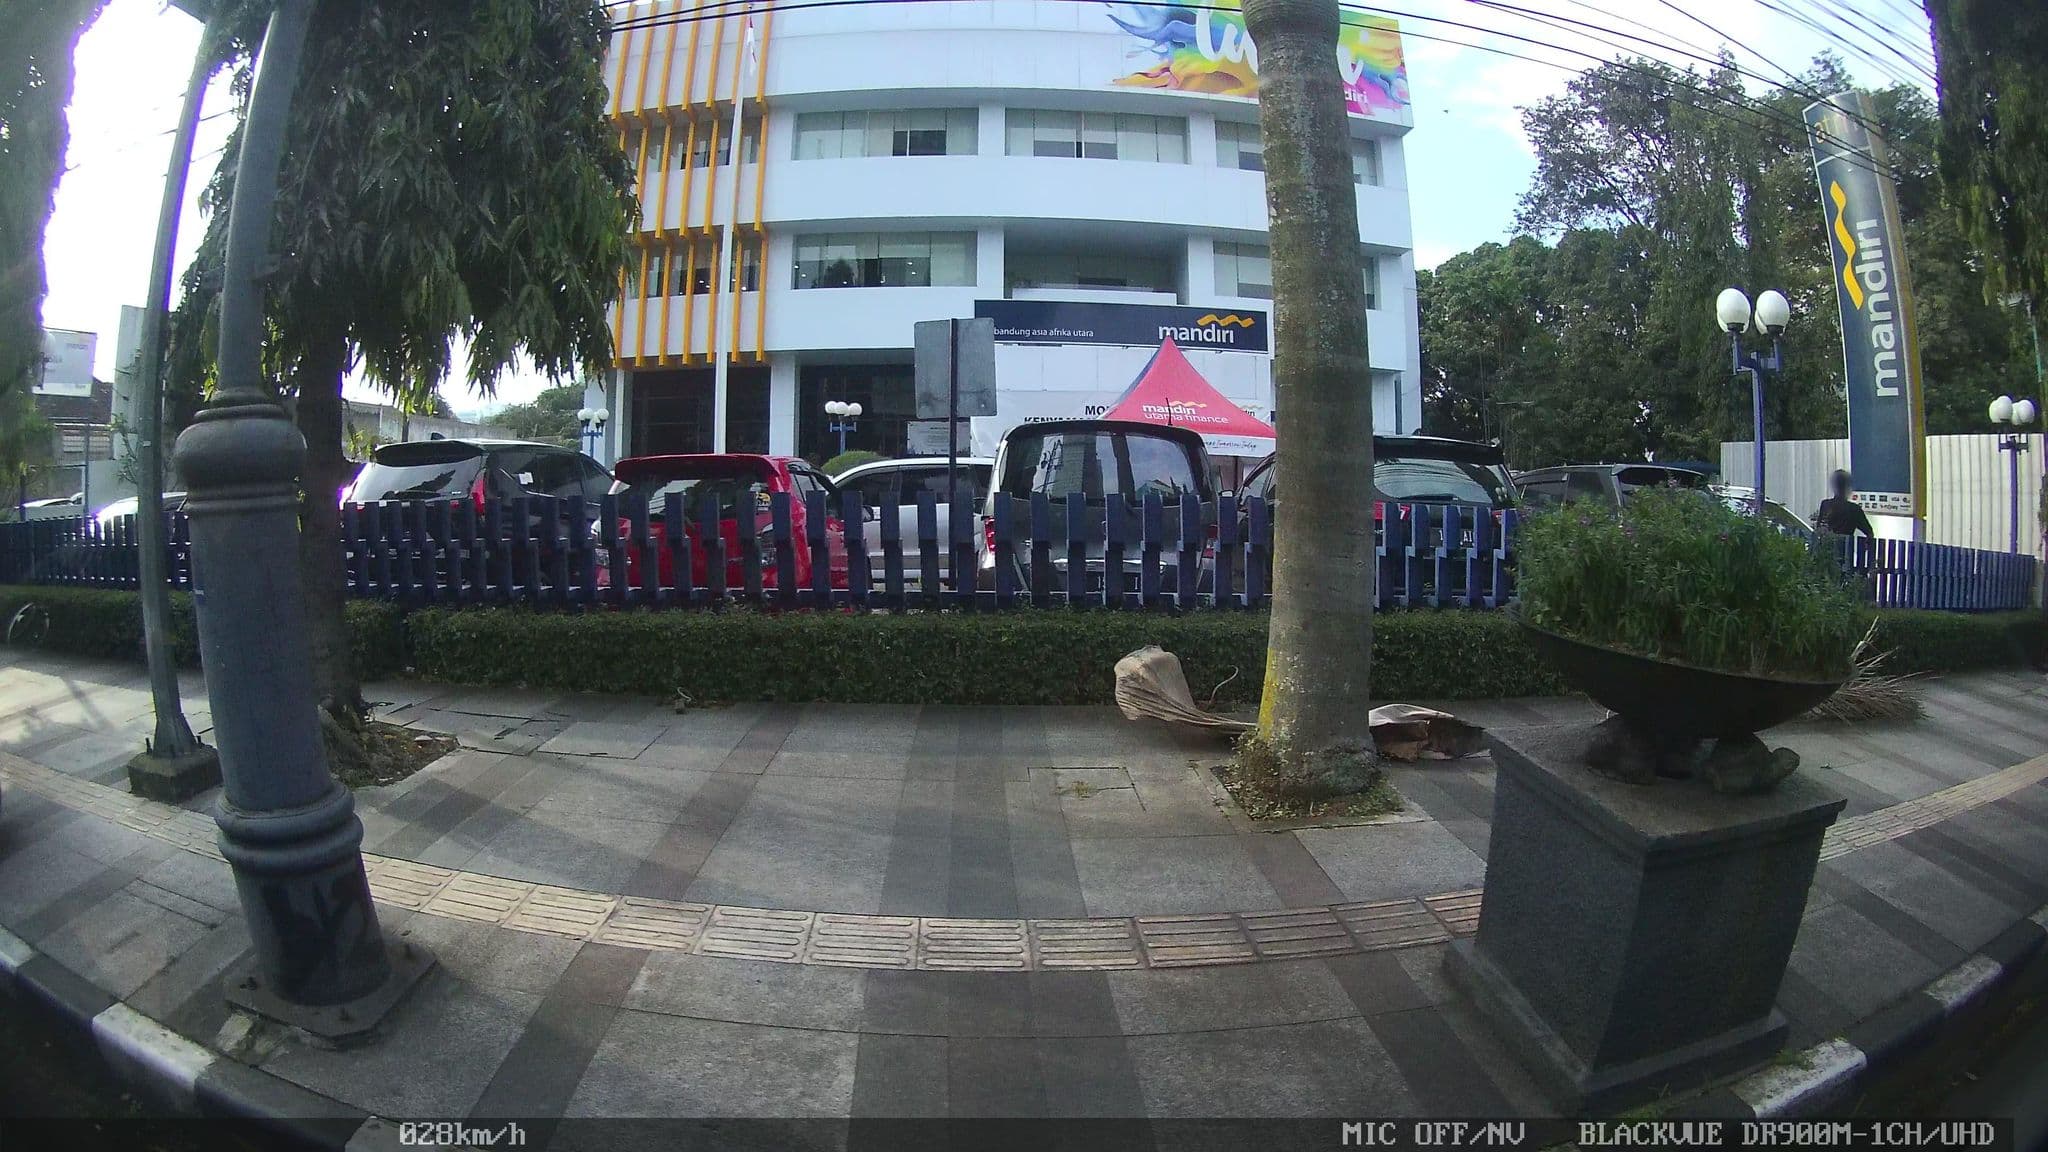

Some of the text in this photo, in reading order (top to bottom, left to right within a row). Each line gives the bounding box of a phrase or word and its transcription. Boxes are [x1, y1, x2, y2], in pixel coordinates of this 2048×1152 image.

[1855, 219, 1899, 397] mandiri
[993, 327, 1031, 338] bandung
[1048, 328, 1072, 337] afrika
[1072, 329, 1094, 337] utara
[1158, 323, 1235, 344] mandiri
[1142, 403, 1196, 415] mandiri
[1143, 412, 1230, 424] utama finance
